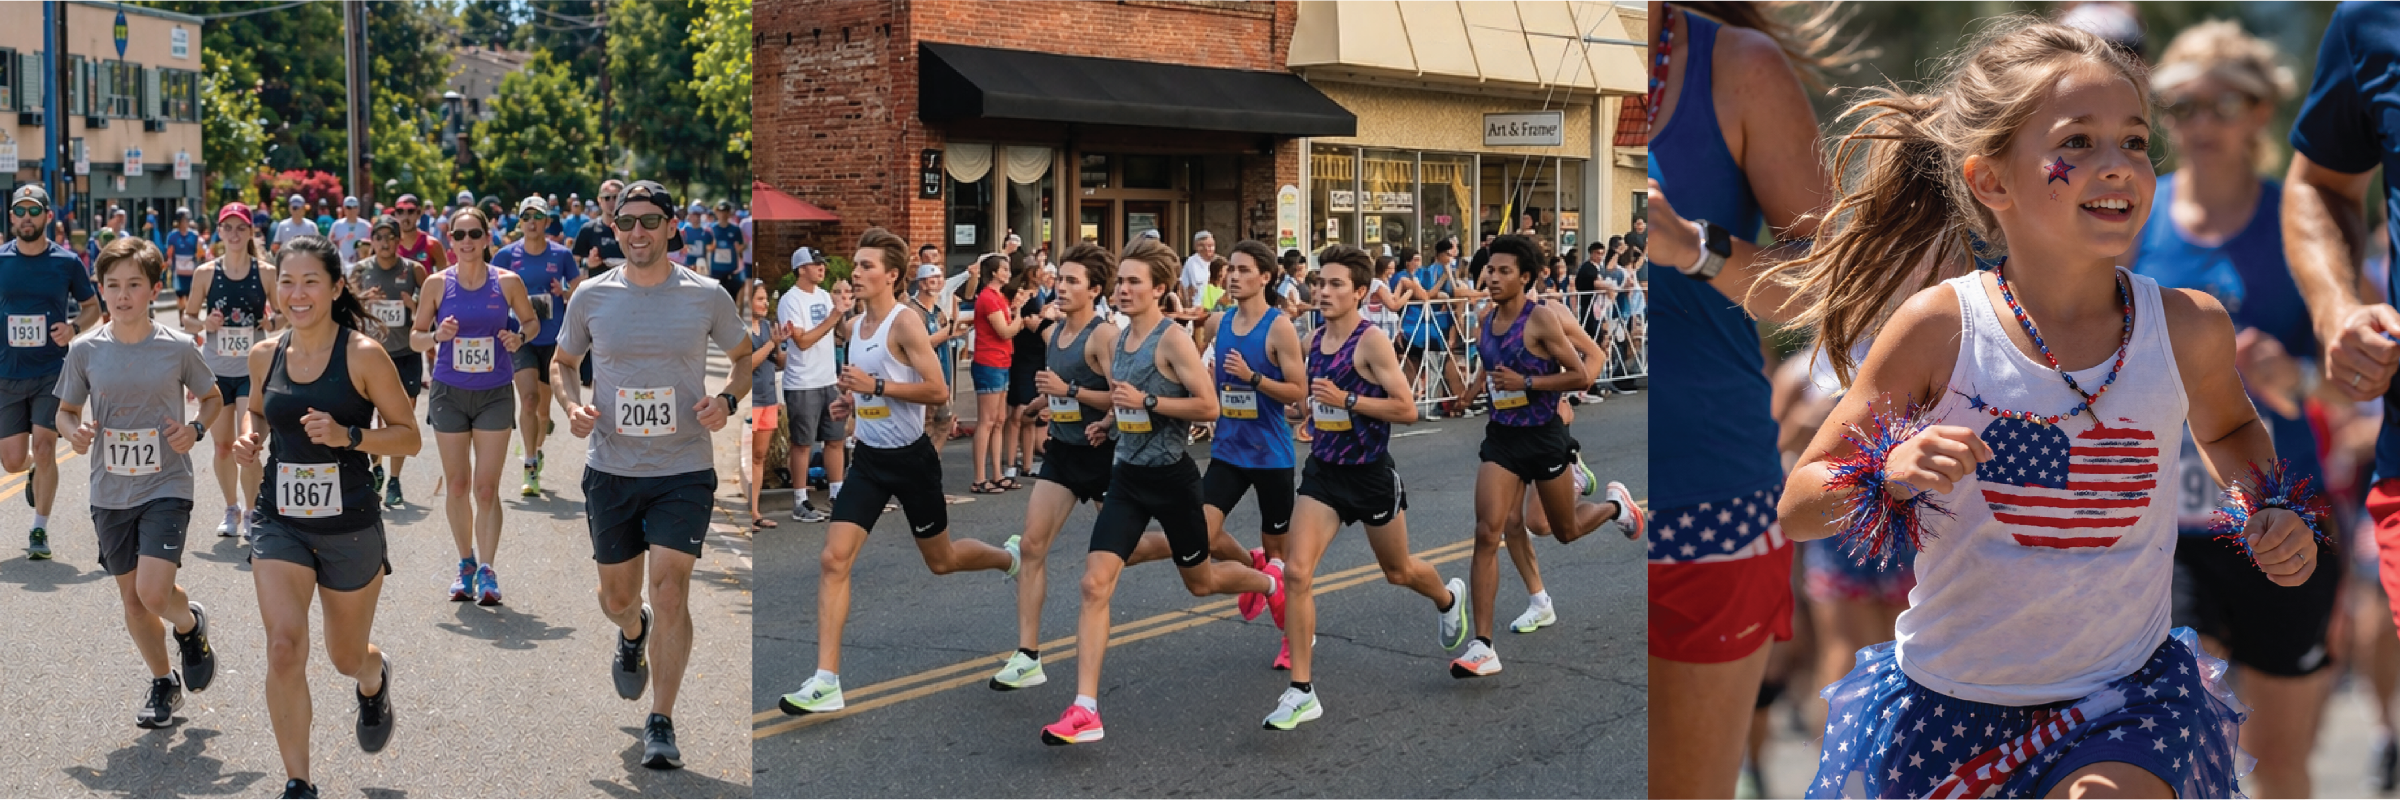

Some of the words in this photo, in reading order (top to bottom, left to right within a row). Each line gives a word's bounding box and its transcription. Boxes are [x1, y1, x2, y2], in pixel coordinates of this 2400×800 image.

[1487, 122, 1506, 137] Art
[1508, 122, 1519, 137] &
[1521, 121, 1557, 137] Frame
[12, 326, 41, 340] 1931
[221, 337, 249, 350] 1265
[458, 349, 489, 365] 1654
[622, 402, 671, 427] 2043
[109, 443, 155, 466] 1712
[282, 481, 333, 506] 1867
